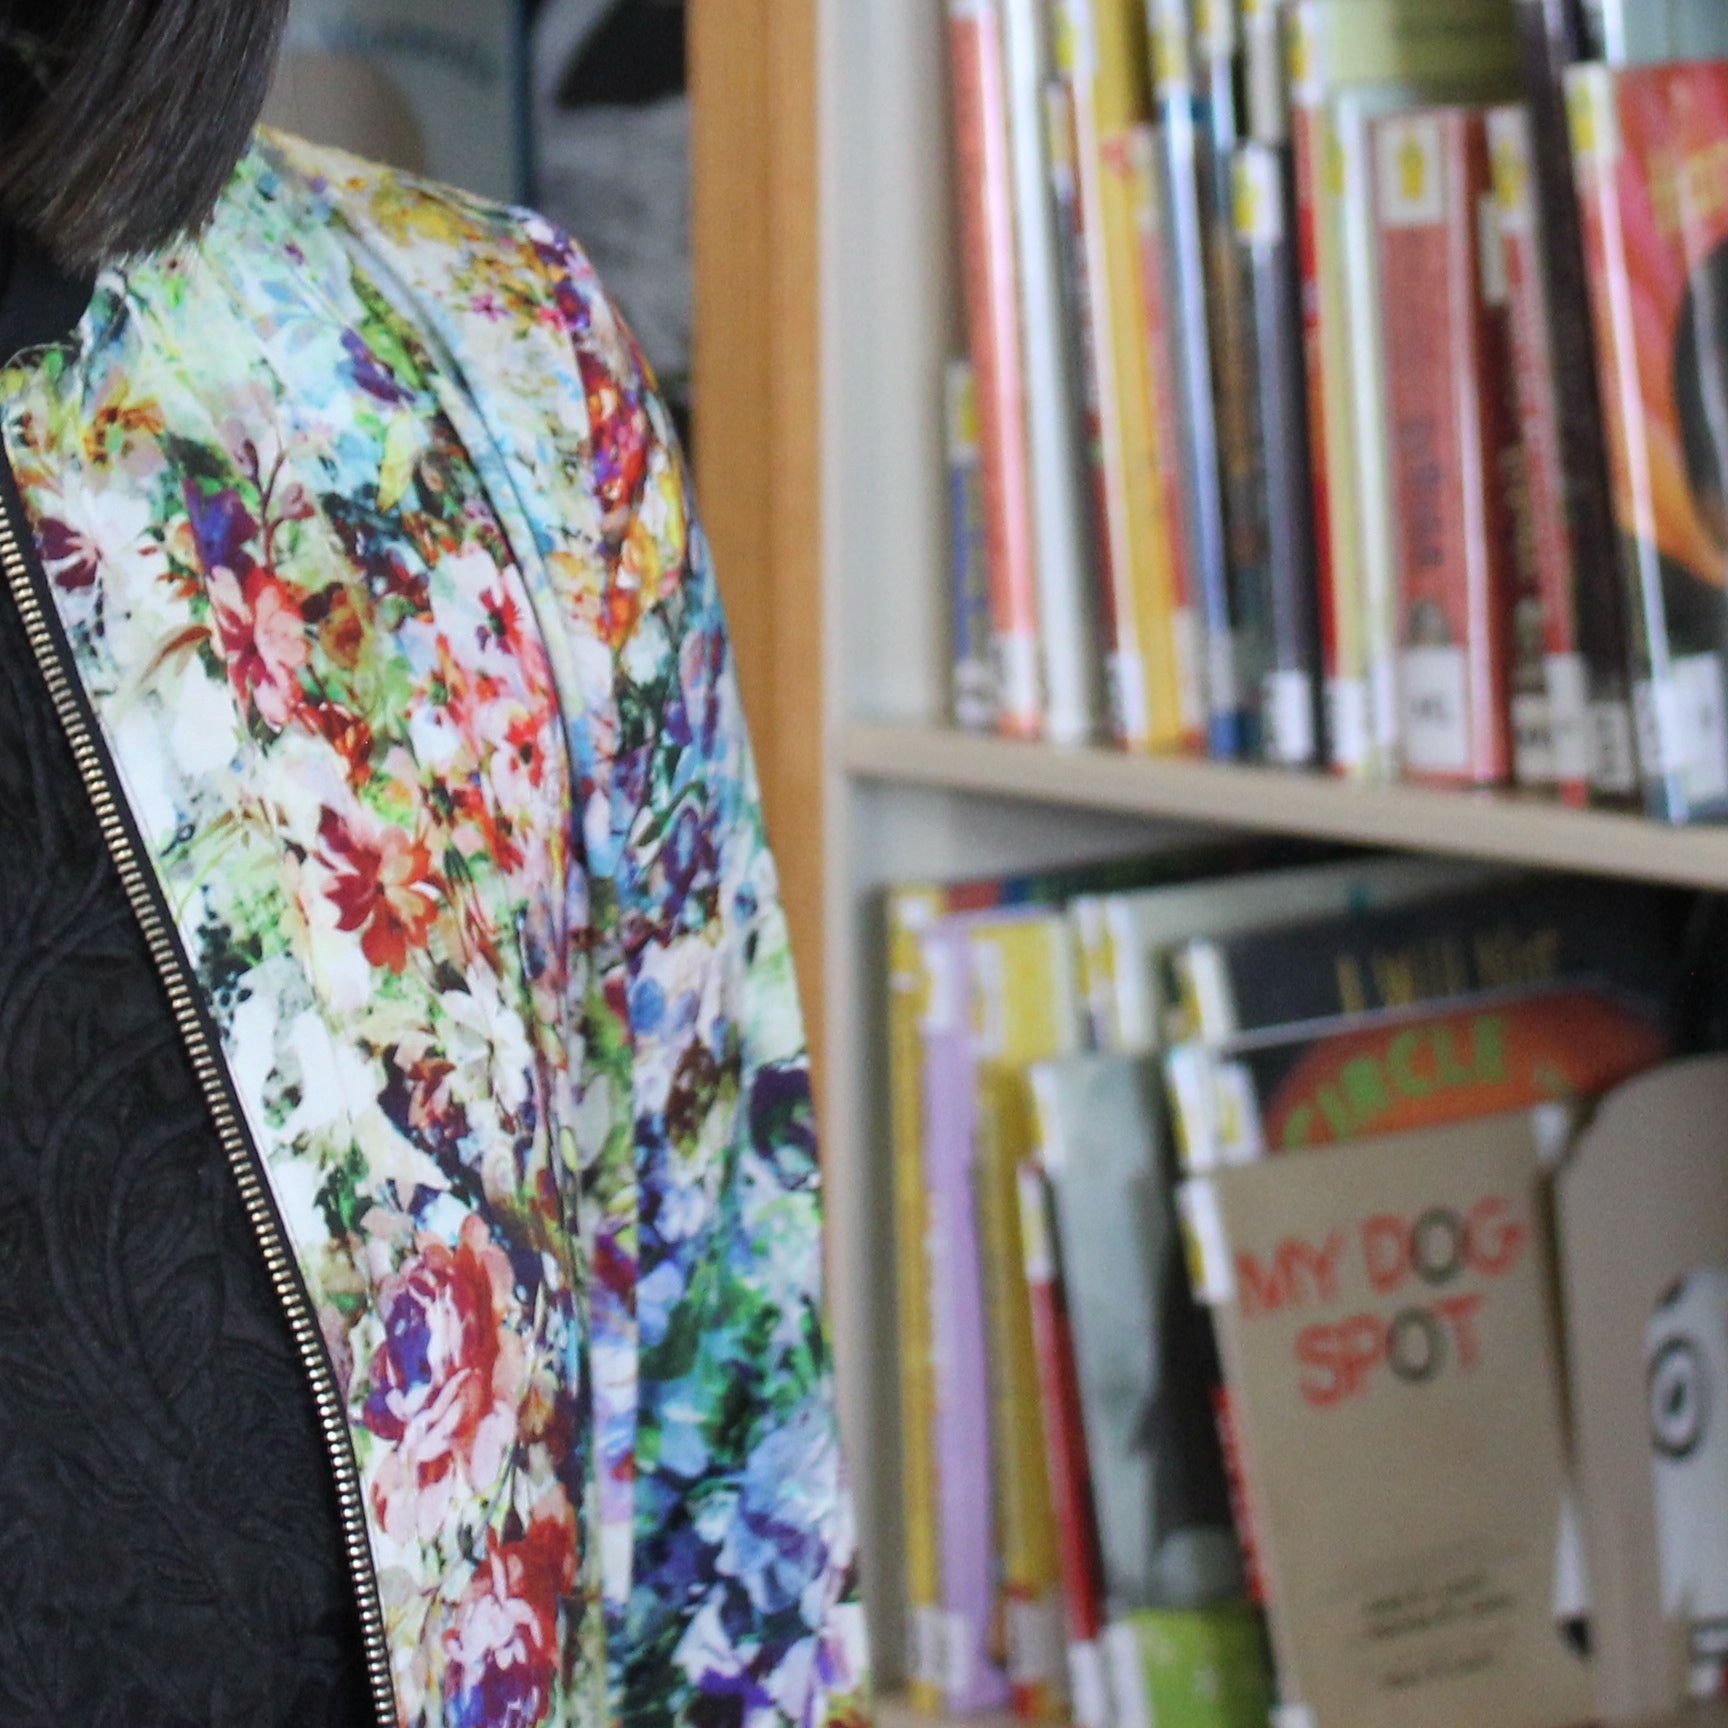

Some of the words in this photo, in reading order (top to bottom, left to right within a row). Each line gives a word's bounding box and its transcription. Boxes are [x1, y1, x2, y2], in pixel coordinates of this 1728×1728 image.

[1282, 1015, 1507, 1152] CIRCLE
[1234, 1228, 1350, 1319] MY
[1361, 1193, 1529, 1295] DOG
[1295, 1292, 1485, 1410] SPOT
